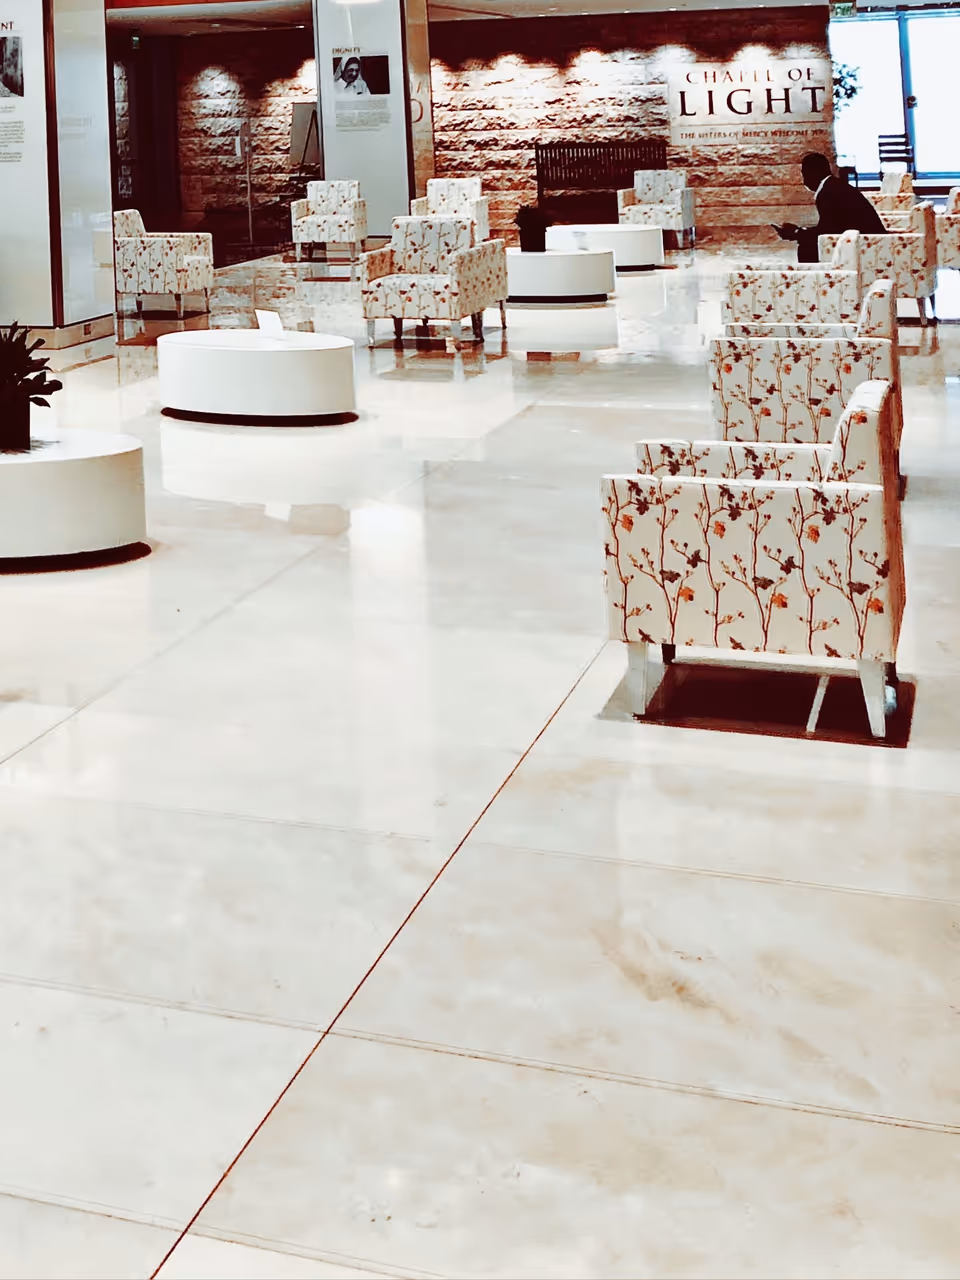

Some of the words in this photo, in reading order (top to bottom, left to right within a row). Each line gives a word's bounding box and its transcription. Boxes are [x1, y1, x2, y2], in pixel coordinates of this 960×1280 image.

[686, 70, 774, 83] CHAPEL
[787, 67, 815, 82] OF
[679, 87, 825, 116] LIGHT
